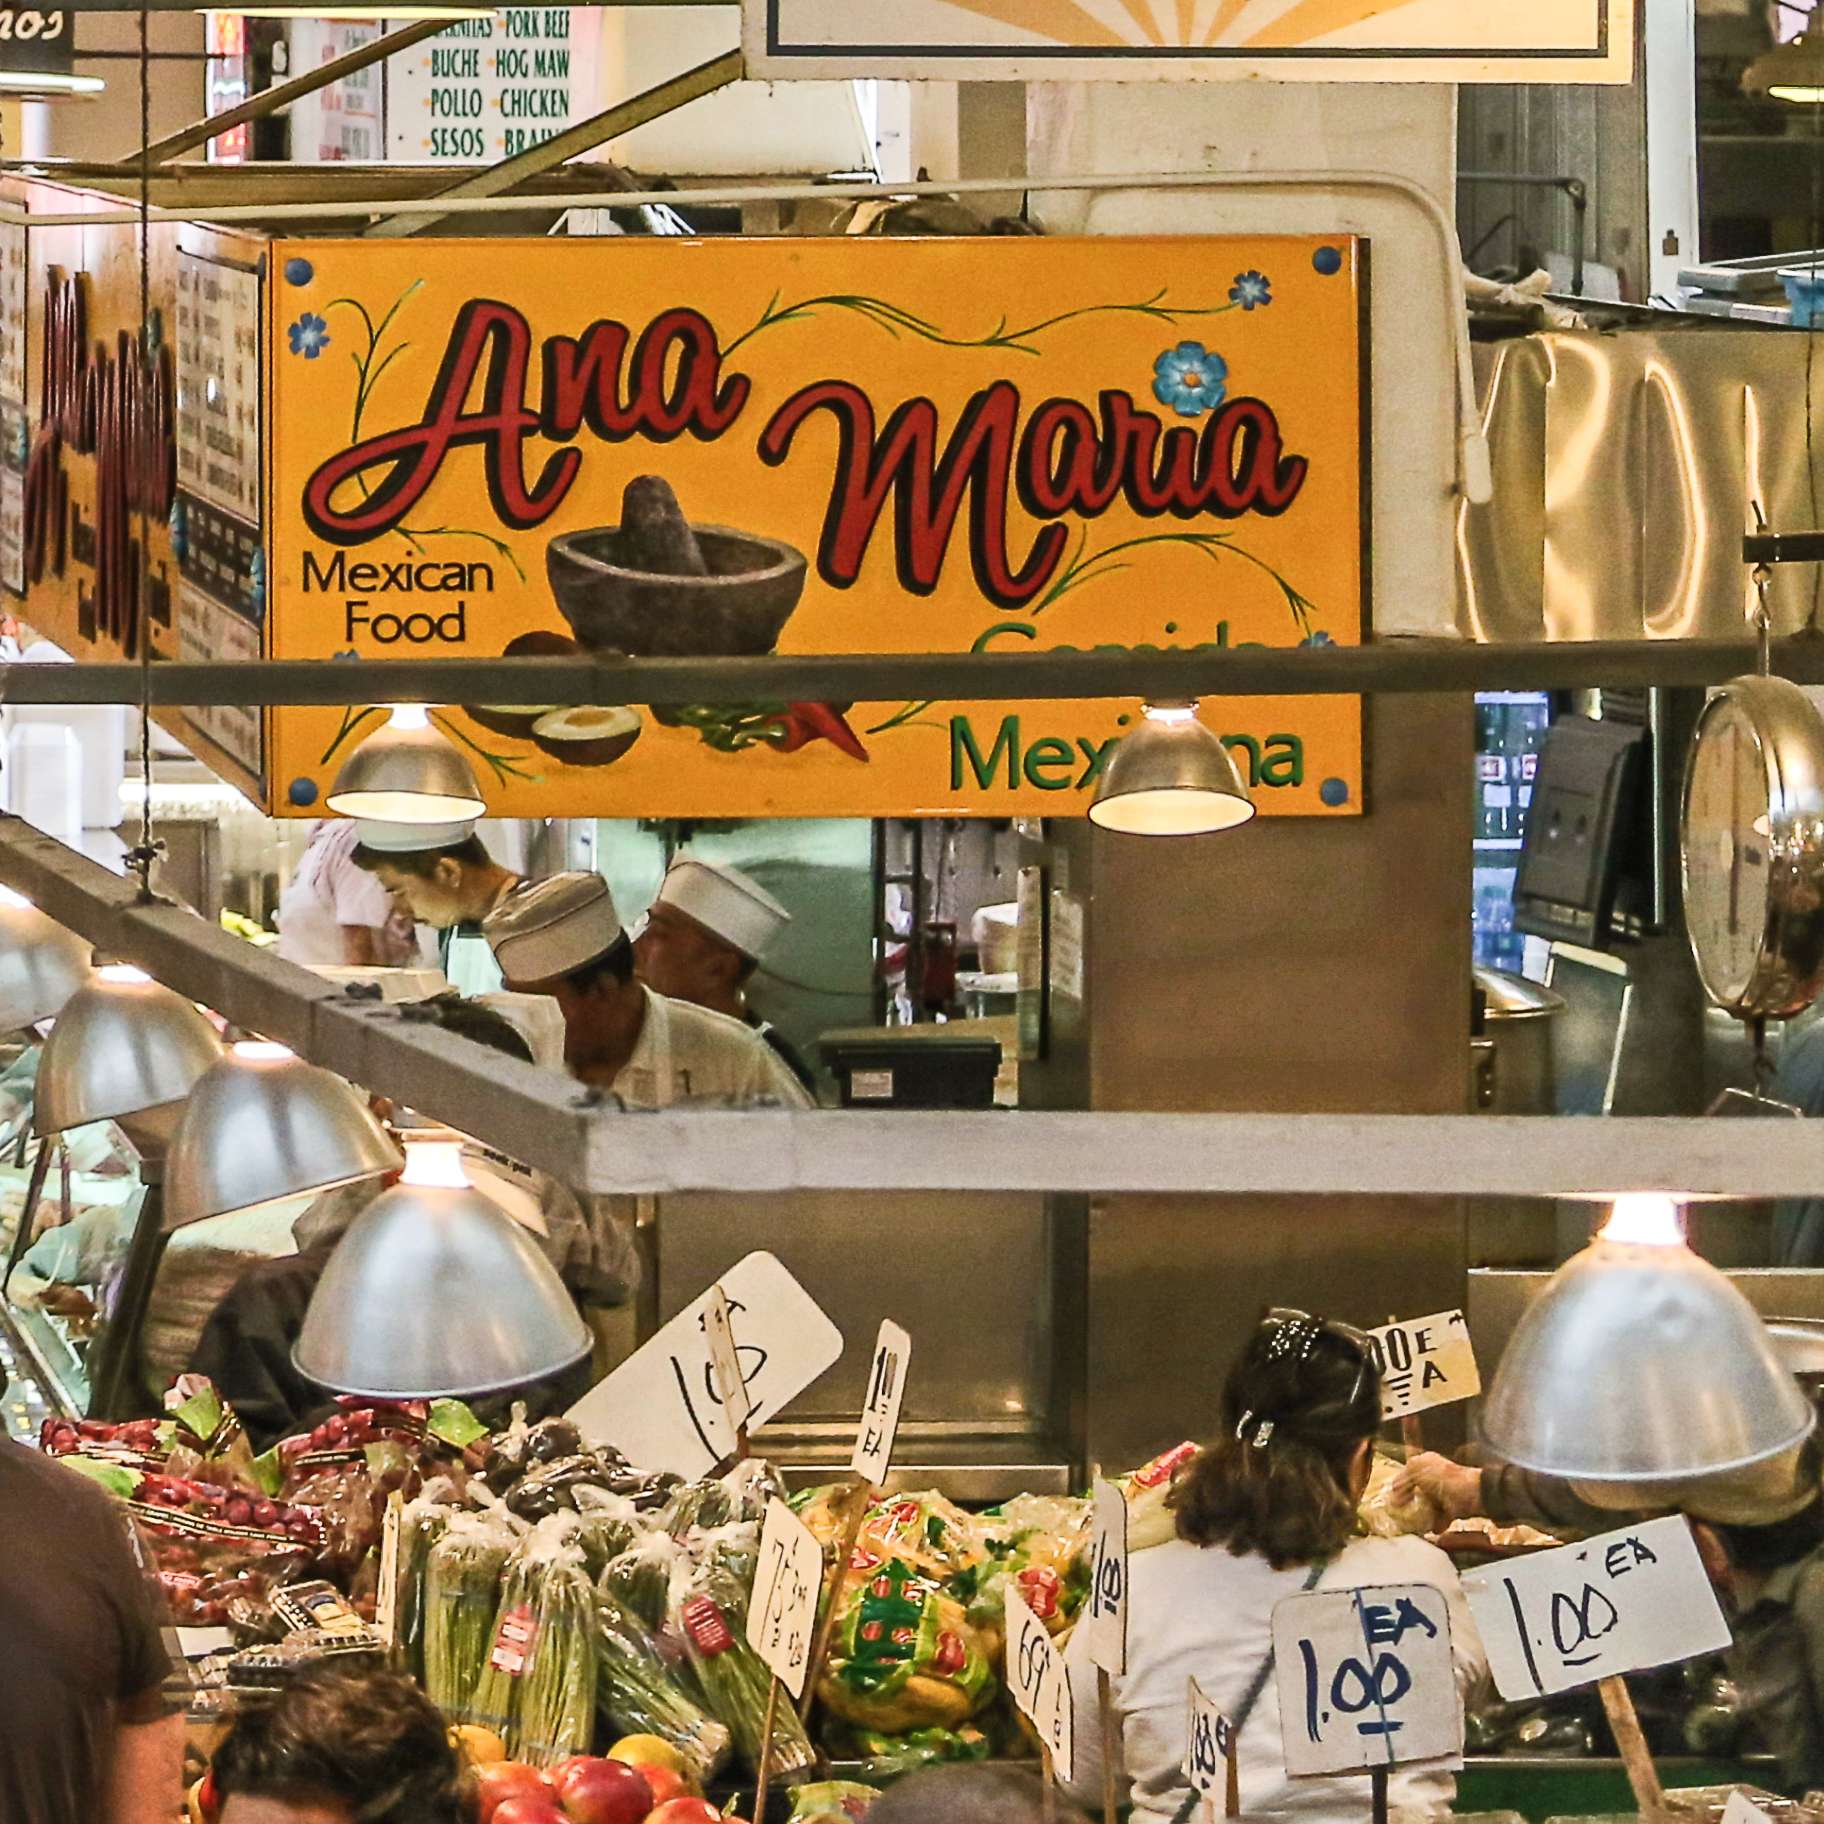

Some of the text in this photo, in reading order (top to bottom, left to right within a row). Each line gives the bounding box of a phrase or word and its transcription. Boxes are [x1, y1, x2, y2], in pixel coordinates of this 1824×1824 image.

[505, 9, 539, 39] PORK
[431, 48, 570, 78] BUCHE HOG MAW
[430, 88, 570, 119] POLLO CHICKEN
[430, 128, 485, 158] SESOS
[301, 295, 754, 544] Ana
[756, 374, 1311, 613] Maria
[300, 548, 496, 597] Mexican
[342, 597, 468, 646] Food
[1604, 1535, 1659, 1579] EA
[1363, 1597, 1438, 1646] EA
[1503, 1577, 1620, 1696] 1.00
[1297, 1637, 1413, 1744] 1.00
